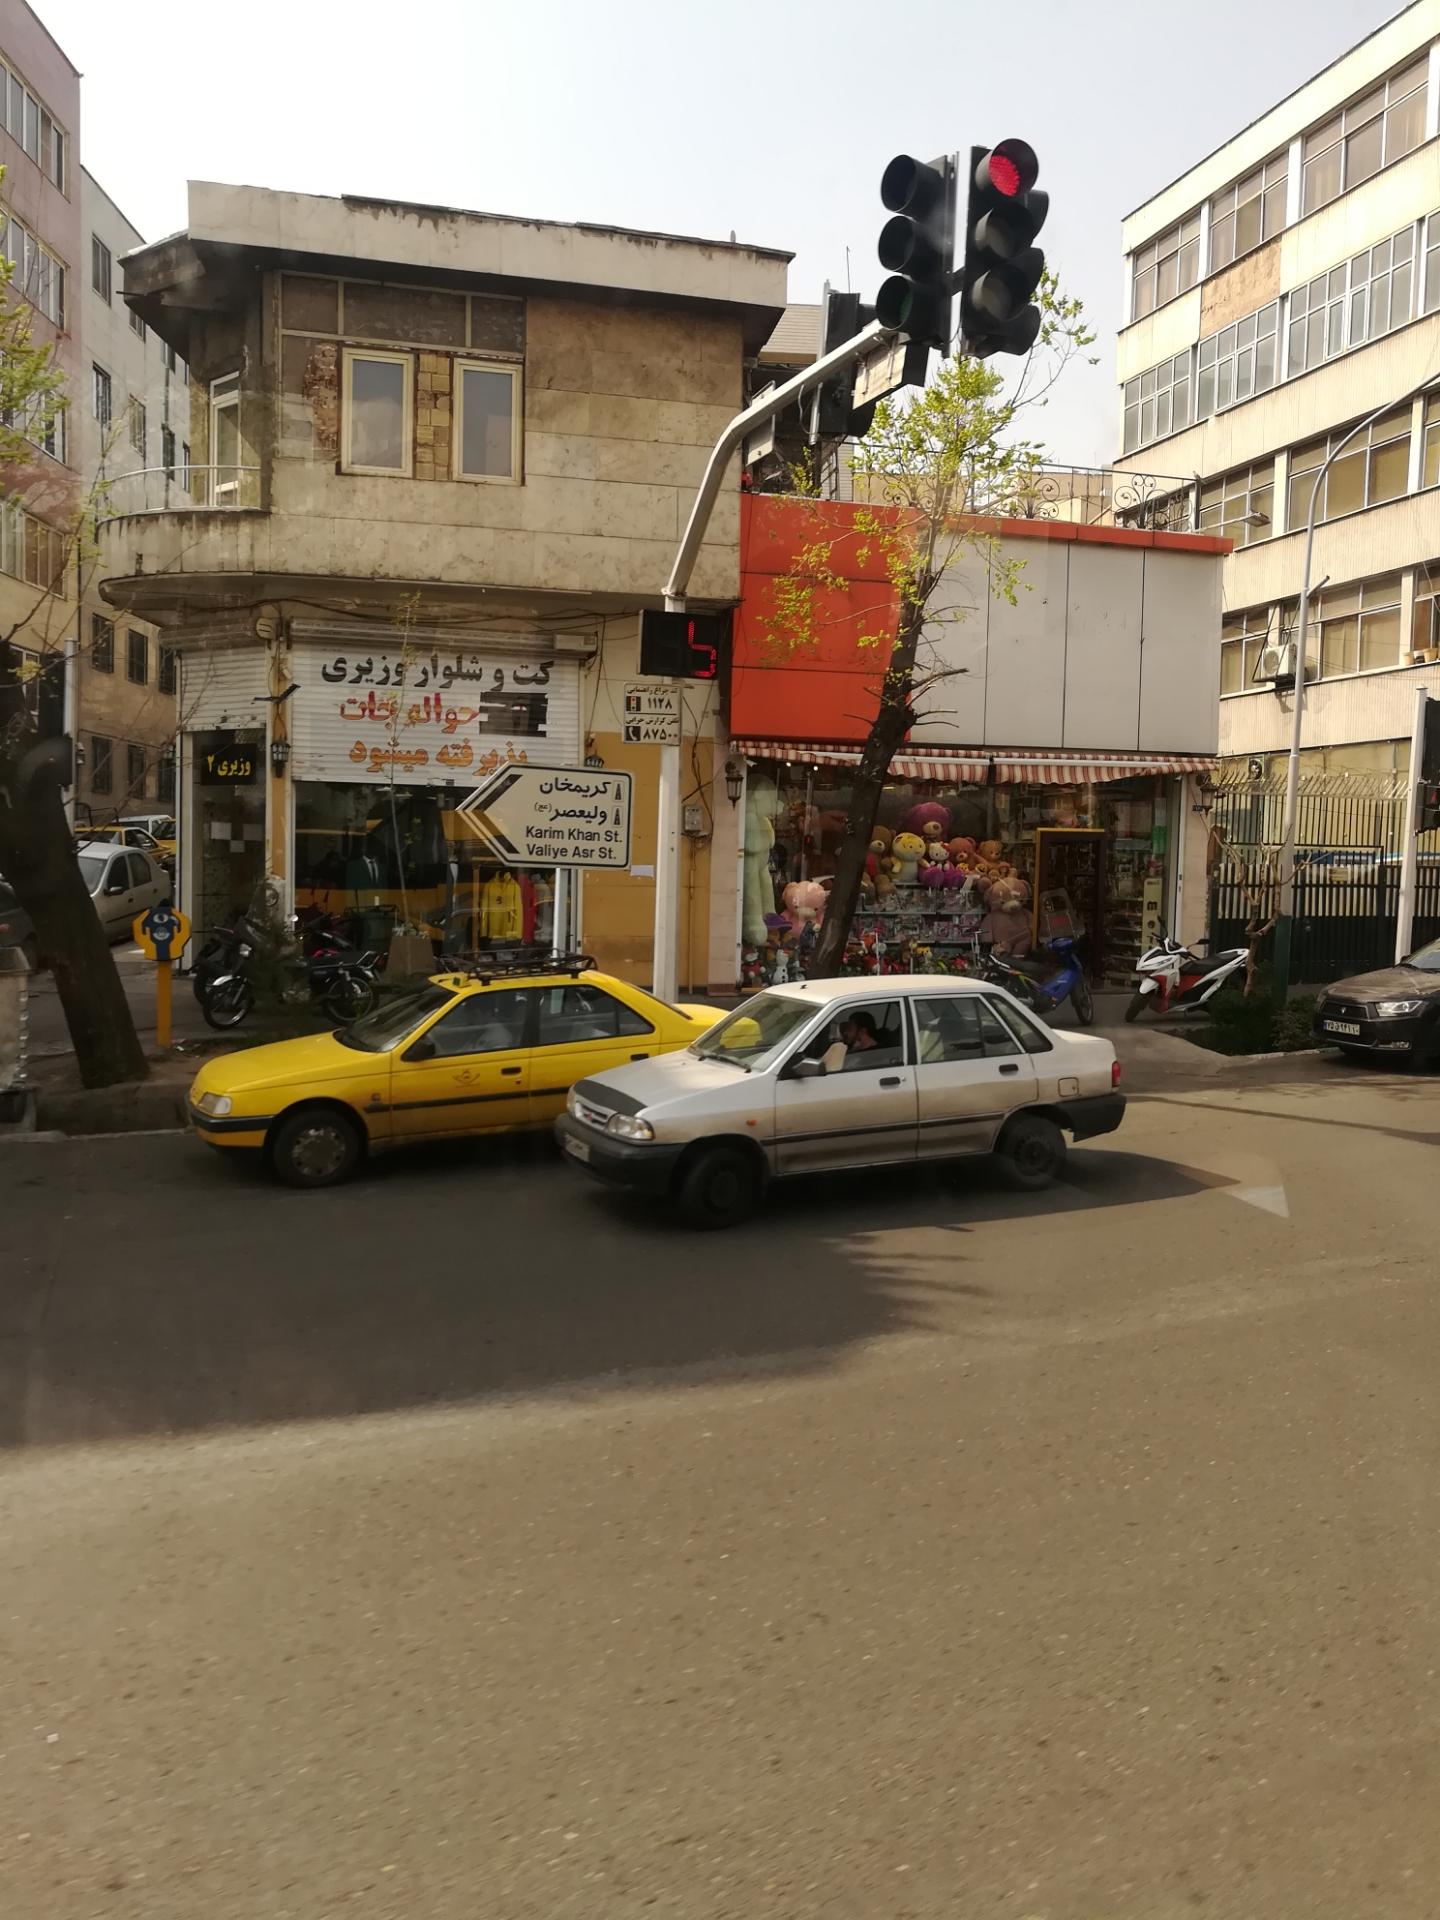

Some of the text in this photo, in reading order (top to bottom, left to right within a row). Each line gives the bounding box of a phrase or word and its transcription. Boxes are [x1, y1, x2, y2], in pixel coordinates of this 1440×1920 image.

[321, 653, 555, 692] کت و شلوار وزیری
[647, 696, 673, 710] ۱۱۲۸
[642, 728, 678, 740] ۸۷۵۰۰
[348, 736, 430, 773] میشود
[207, 754, 252, 777] وزیری ۲
[539, 777, 612, 798] کریمخان
[549, 805, 608, 825] ولیعصر
[525, 825, 623, 843] Karim Khan St.
[526, 843, 617, 860] Valiye Asr St.
